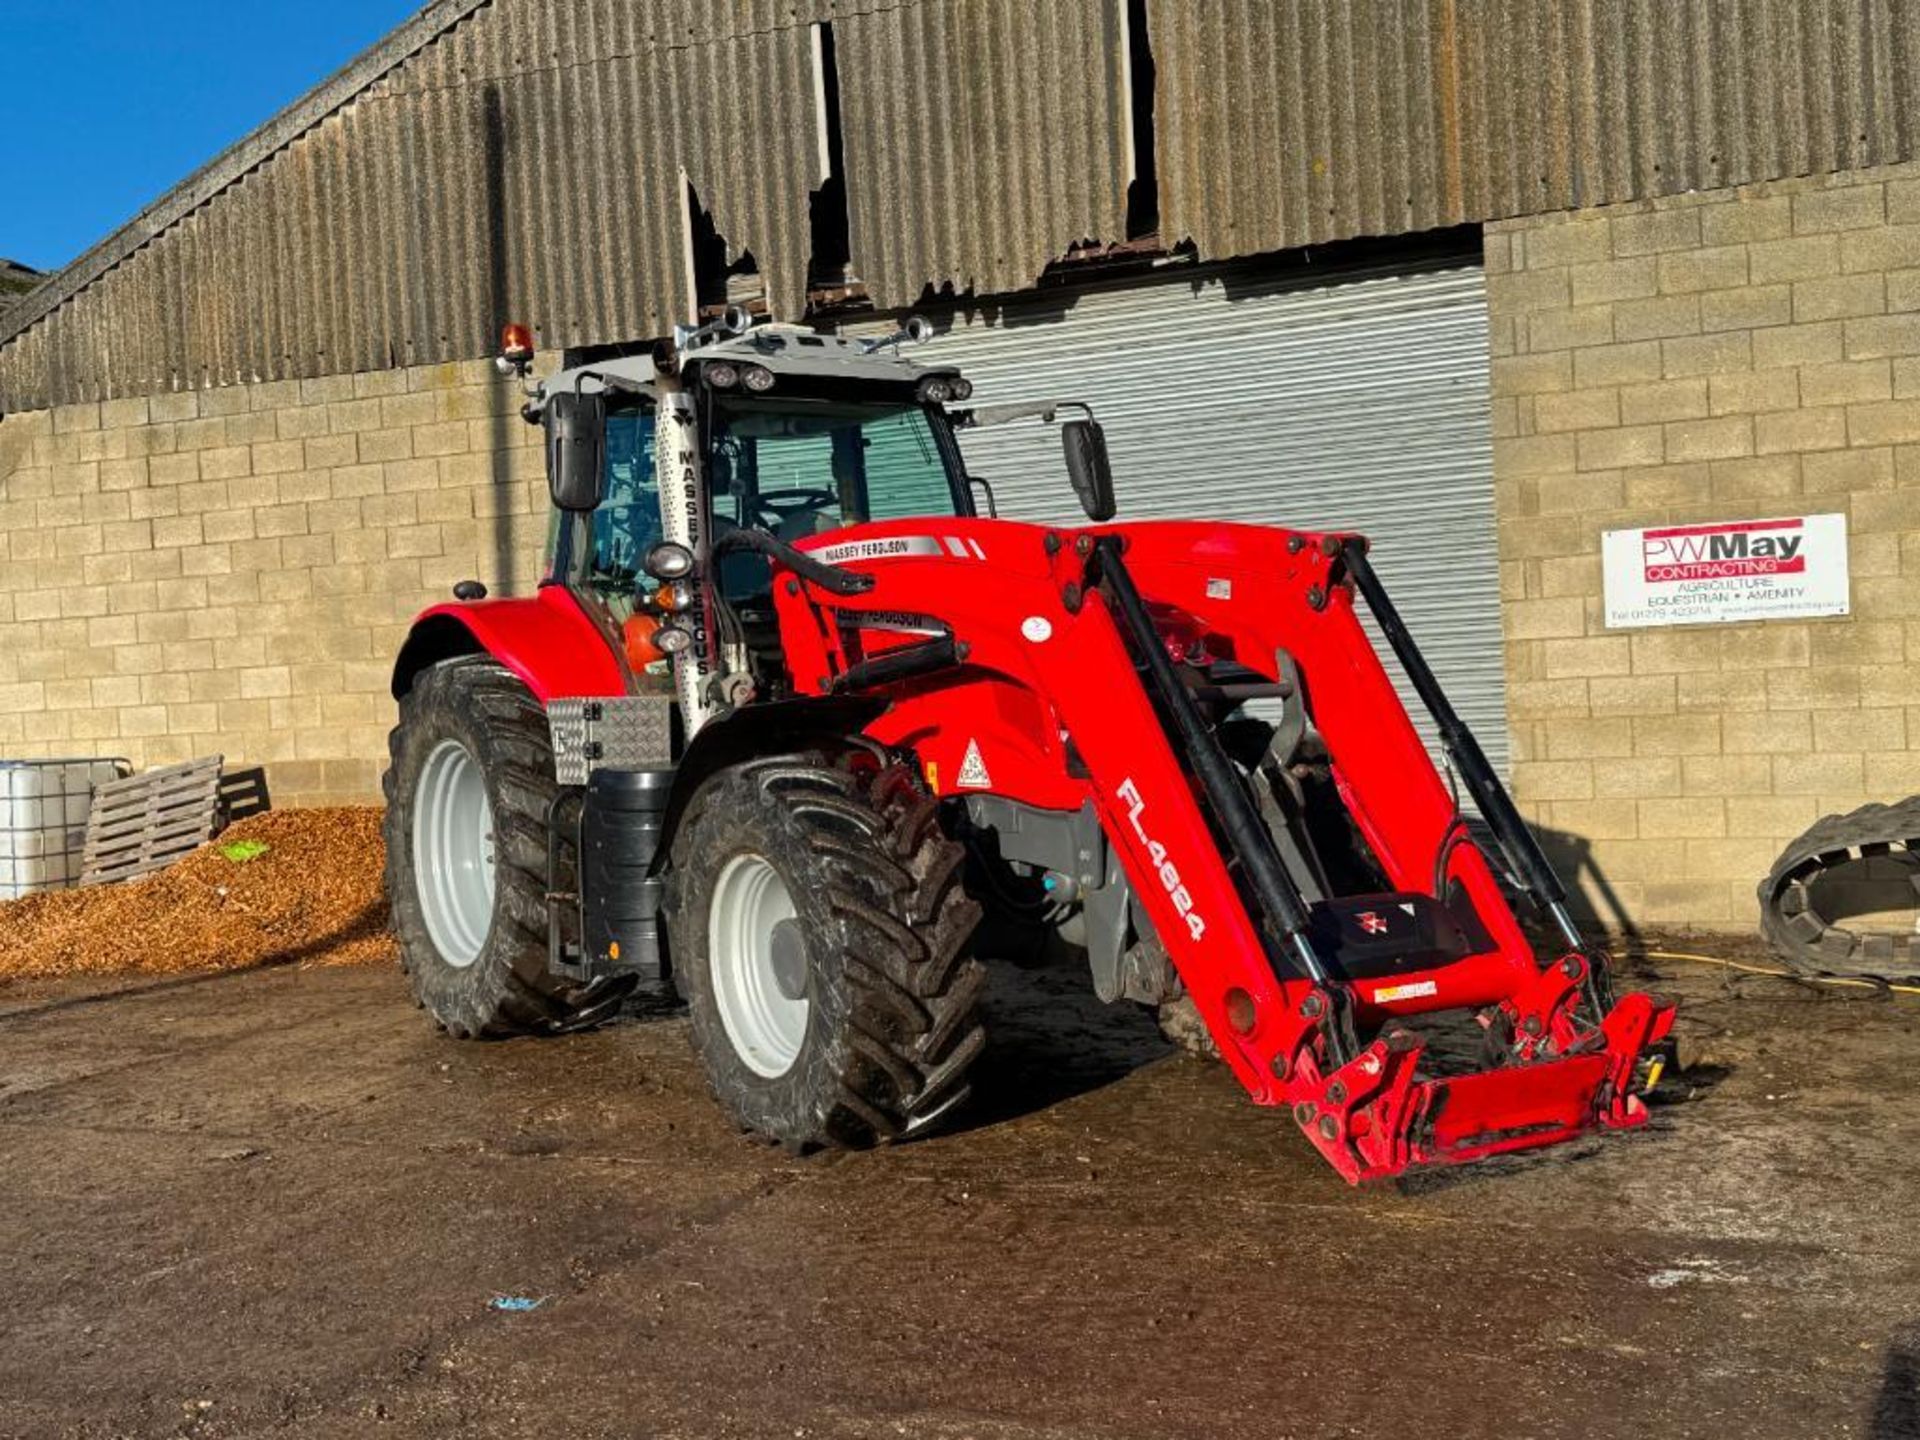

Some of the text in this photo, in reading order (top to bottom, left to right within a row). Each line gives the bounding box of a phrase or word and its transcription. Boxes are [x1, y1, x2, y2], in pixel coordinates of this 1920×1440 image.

[825, 540, 908, 561] MASSEY FERGUSON
[679, 451, 710, 709] MASSEY FERGUS
[1646, 559, 1777, 581] CONTRACTING
[1678, 578, 1774, 593] AGRICULTURE
[1648, 593, 1729, 607] EQUESTRIAN
[1747, 588, 1805, 600] AMENITY
